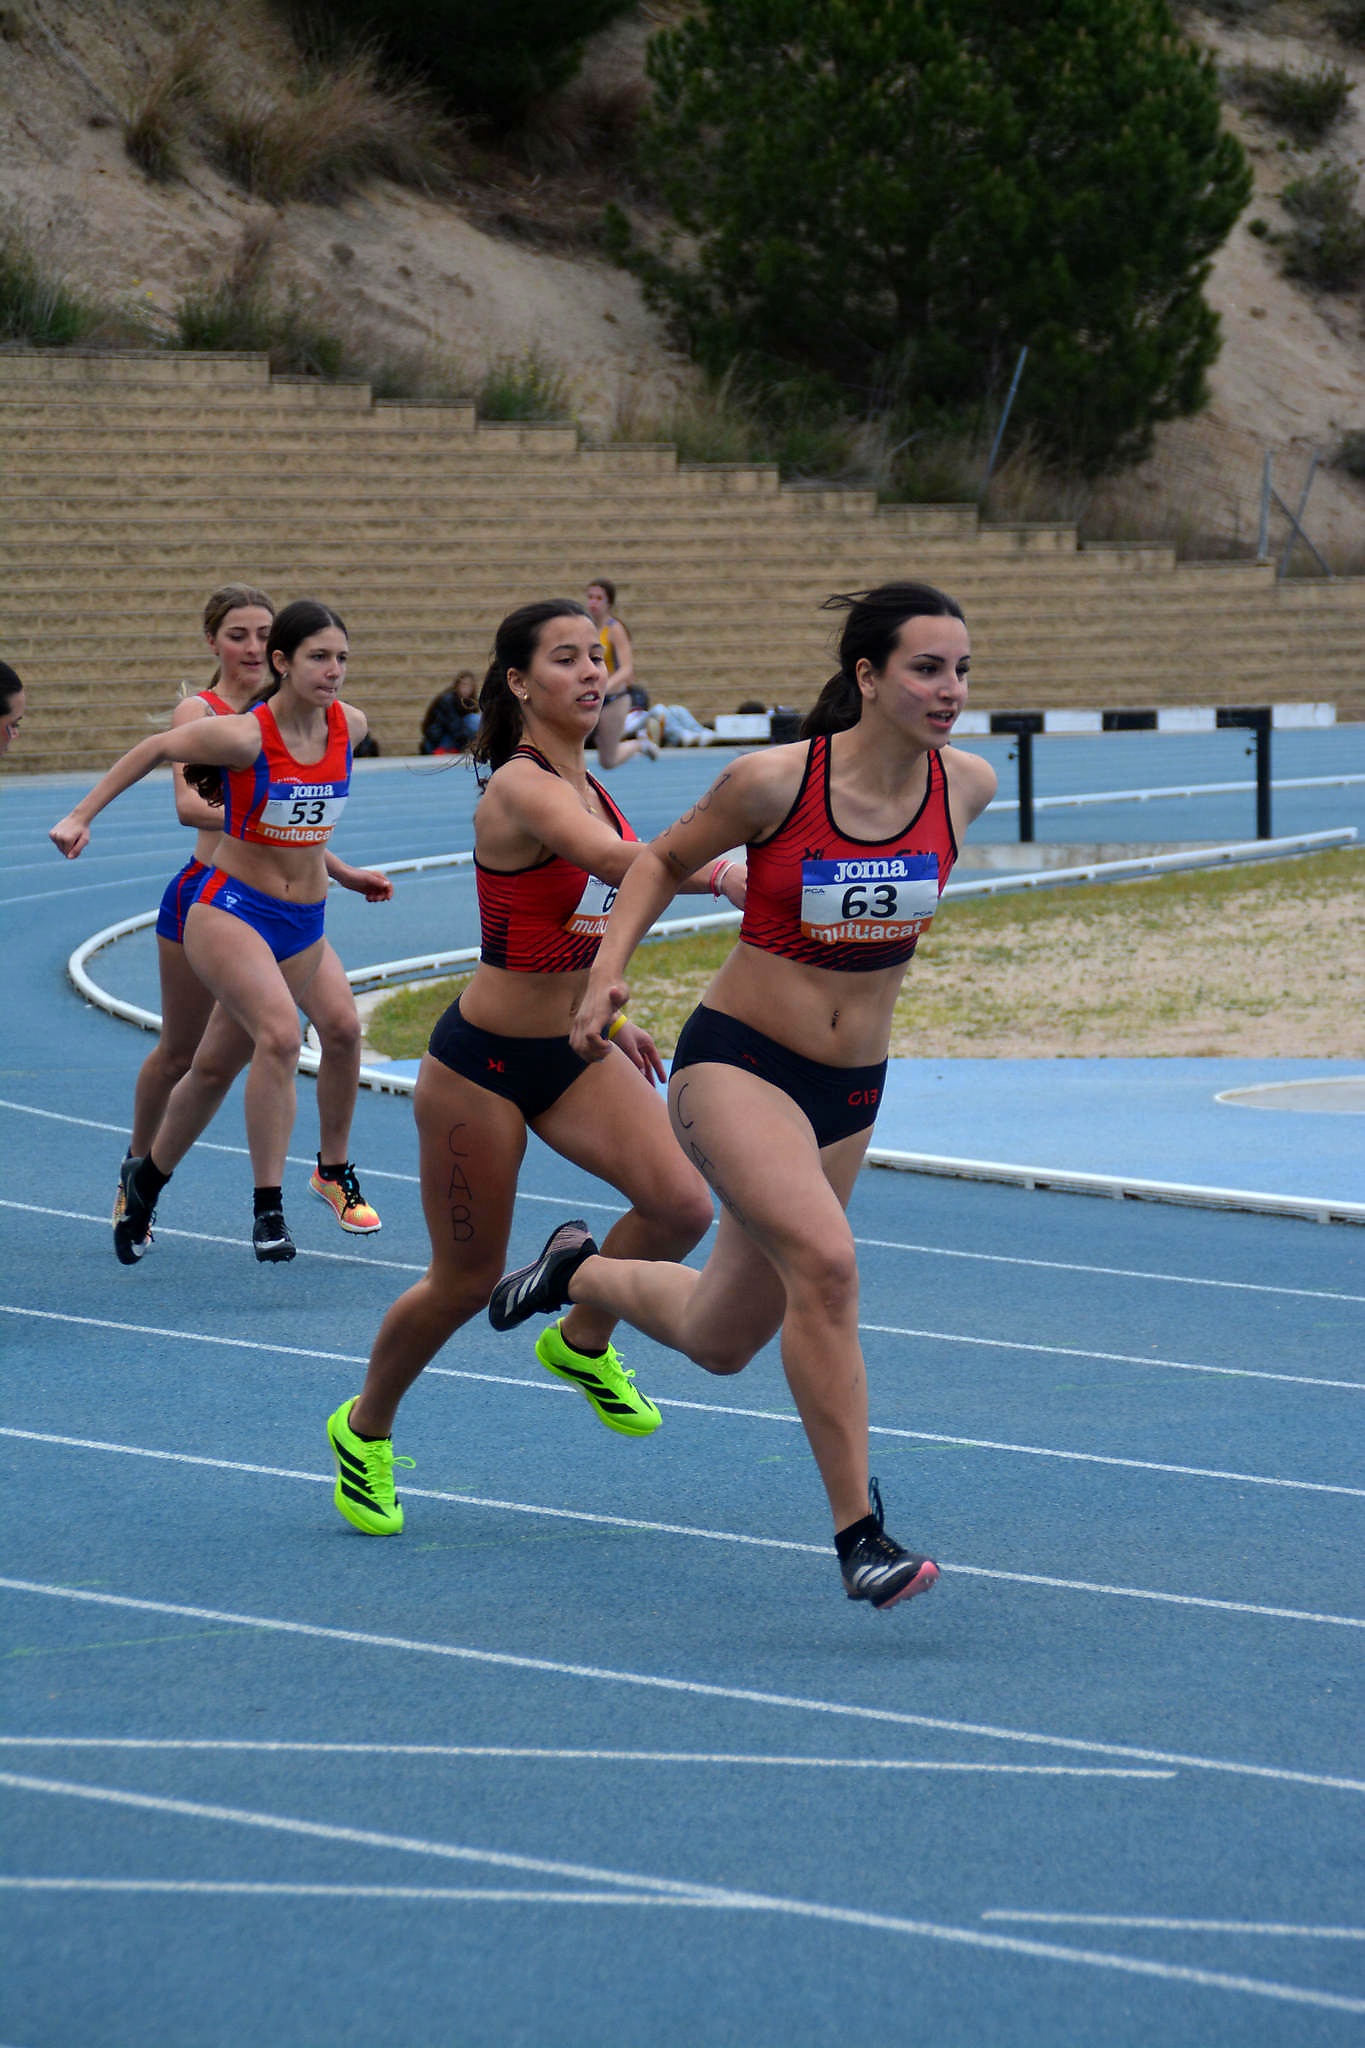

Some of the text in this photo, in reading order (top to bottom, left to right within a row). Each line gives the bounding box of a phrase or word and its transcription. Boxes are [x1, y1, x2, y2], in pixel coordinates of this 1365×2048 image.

[288, 800, 326, 825] 53
[841, 884, 898, 919] 63
[810, 920, 923, 943] mutuacat
[447, 1123, 475, 1242] CAB
